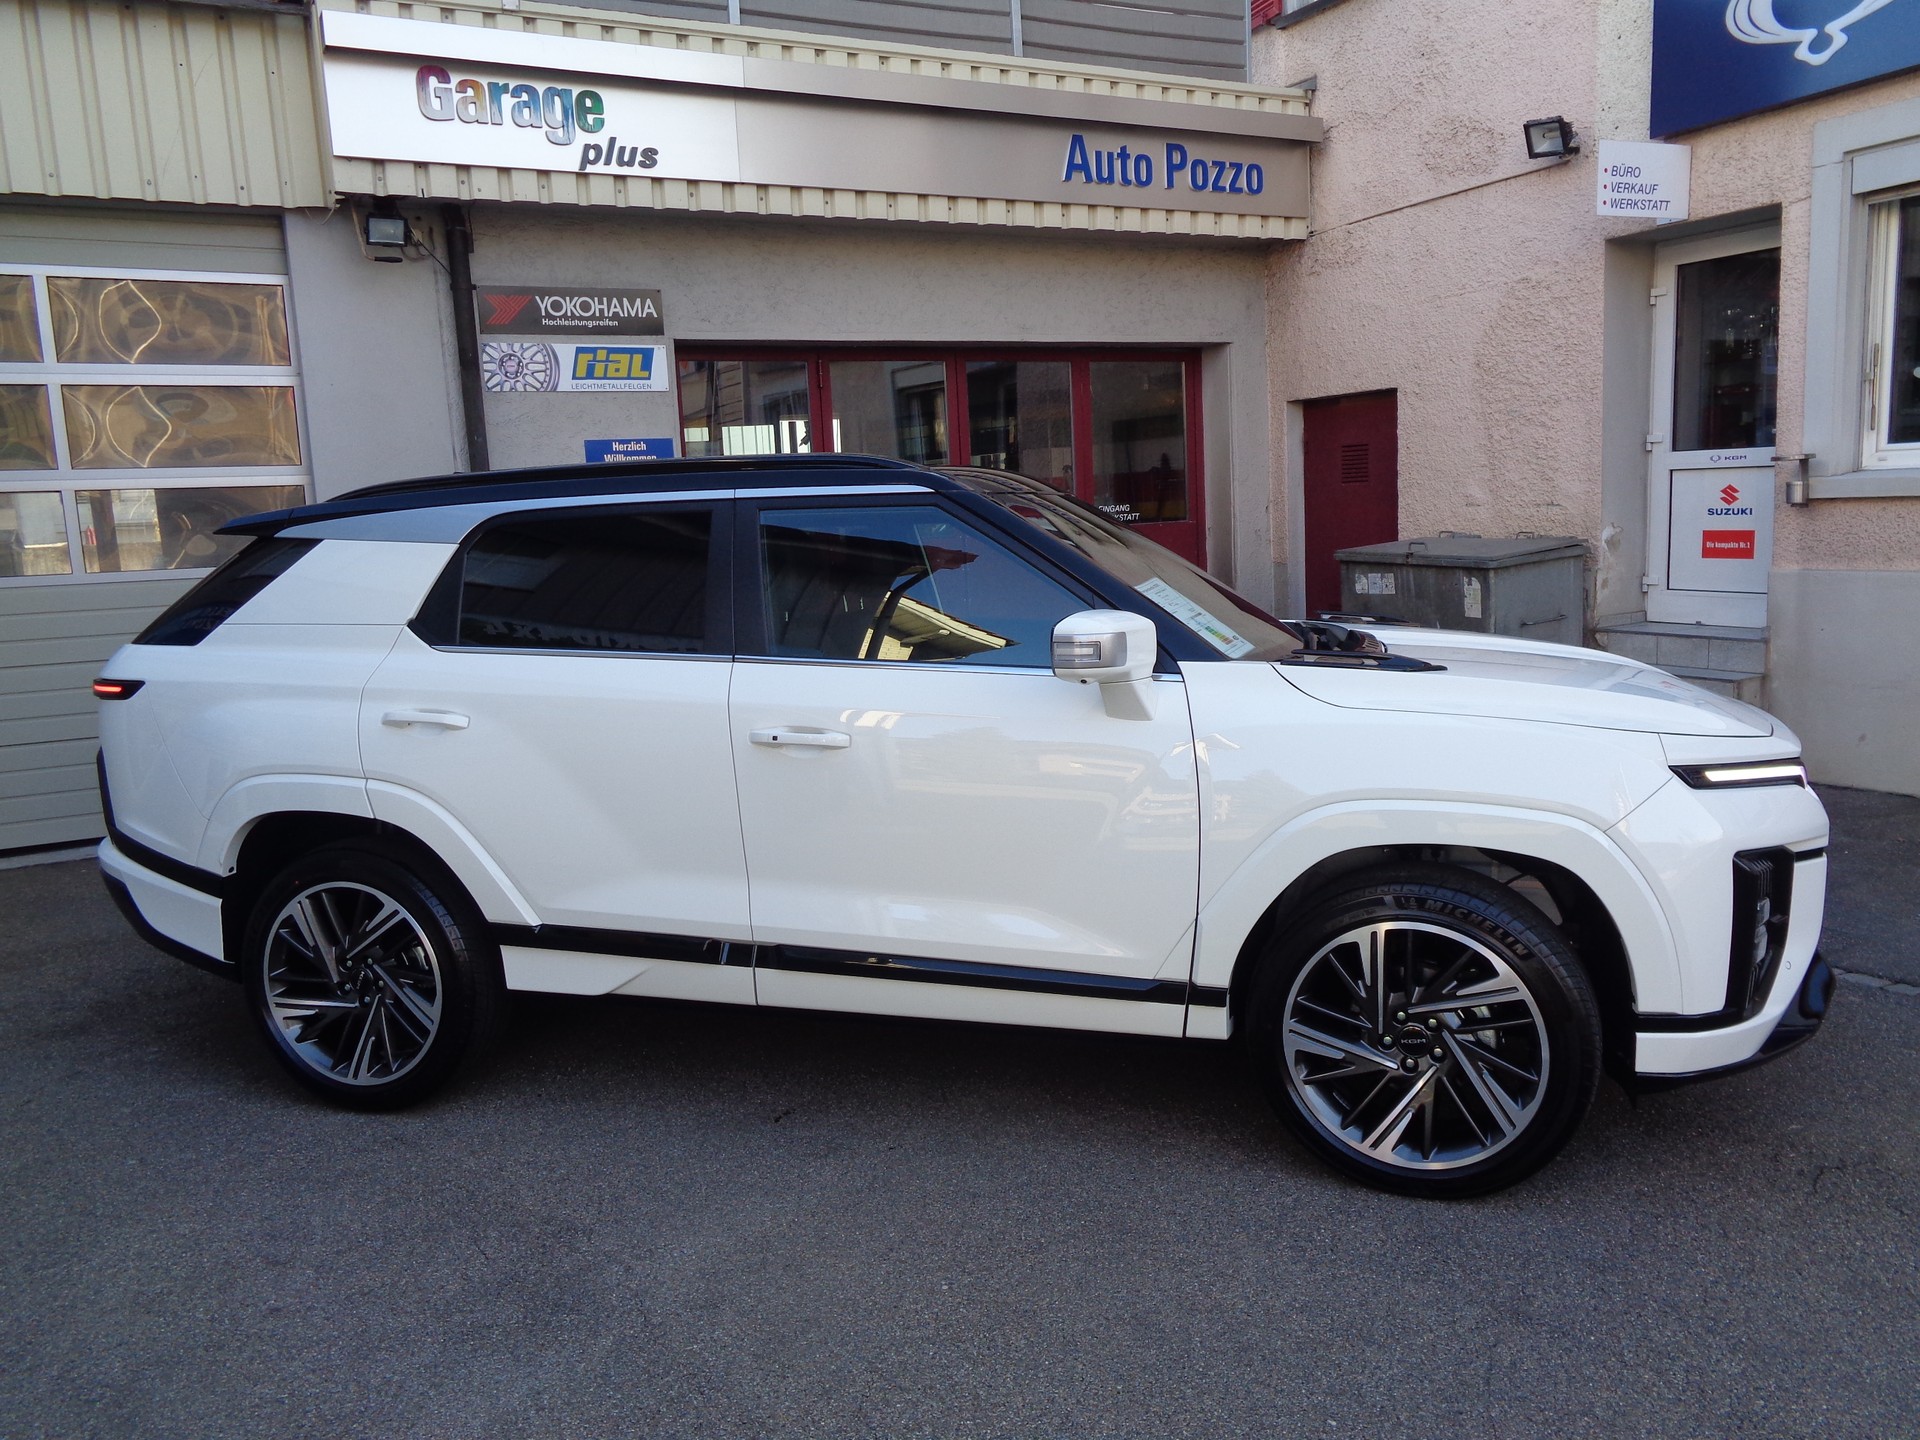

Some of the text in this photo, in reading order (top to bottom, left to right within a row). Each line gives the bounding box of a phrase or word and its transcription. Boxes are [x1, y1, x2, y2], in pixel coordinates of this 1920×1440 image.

[416, 64, 605, 146] Garage
[578, 136, 659, 171] plus
[1061, 133, 1264, 196] Auto Pozzo
[1611, 163, 1642, 178] BÜRO
[1611, 182, 1659, 195] VERKAUF
[1610, 198, 1671, 211] WERKSTATT
[535, 295, 658, 318] YOKOHAMA
[542, 318, 619, 328] Hochleistungsreifen
[612, 441, 647, 452] Herzlich
[1707, 507, 1753, 516] SUZUKI
[1424, 899, 1530, 957] MICHELIN
